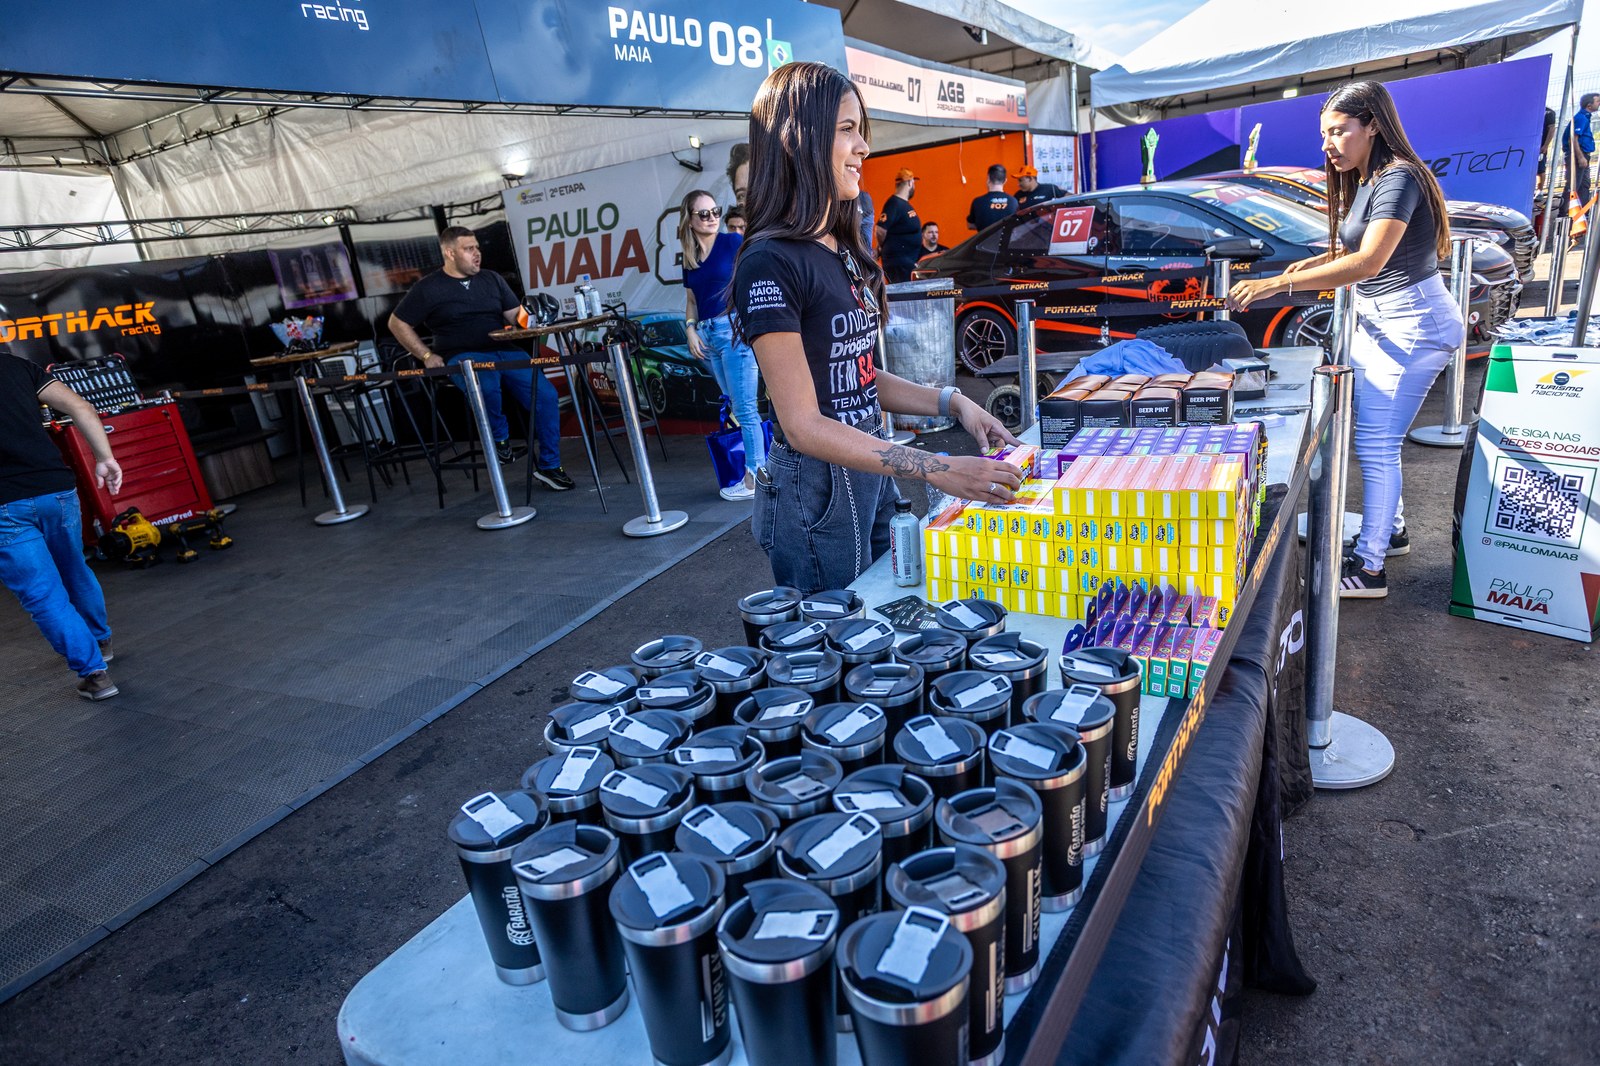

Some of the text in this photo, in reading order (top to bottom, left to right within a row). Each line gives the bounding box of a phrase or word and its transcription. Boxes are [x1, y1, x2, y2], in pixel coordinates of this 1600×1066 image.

[301, 3, 370, 30] racing
[608, 6, 764, 69] PAULO 08
[614, 43, 652, 63] MAIA
[850, 72, 867, 85] NICO
[908, 77, 921, 103] 07
[937, 79, 965, 104] AGB
[559, 182, 586, 196] ETAPA
[527, 203, 620, 245] PAULO
[1060, 219, 1083, 237] 07
[1244, 213, 1282, 231] 07
[528, 228, 650, 289] MAIA
[1010, 282, 1049, 291] PORTHACK
[1101, 273, 1144, 283] PORTHACK
[749, 286, 783, 298] MAIOR,
[927, 288, 963, 297] PORTHACK
[1044, 305, 1098, 315] PORTHACK
[121, 323, 161, 337] racing
[829, 358, 858, 394] TEM
[1531, 389, 1581, 399] nacional
[1535, 383, 1584, 393] TURISMO
[831, 395, 861, 410] TEM
[1501, 426, 1581, 443] ME SIGA NAS
[1499, 437, 1600, 456] REDES SOCIAIS
[1494, 539, 1578, 561] @PAULOMAIA8
[1489, 578, 1553, 601] PAULO
[1486, 590, 1549, 615] MAIA
[1130, 707, 1139, 747] BARATÃO
[1148, 679, 1206, 827] PORTHACK
[1072, 804, 1081, 850] BARATÃO
[502, 886, 526, 929] BARATÃO
